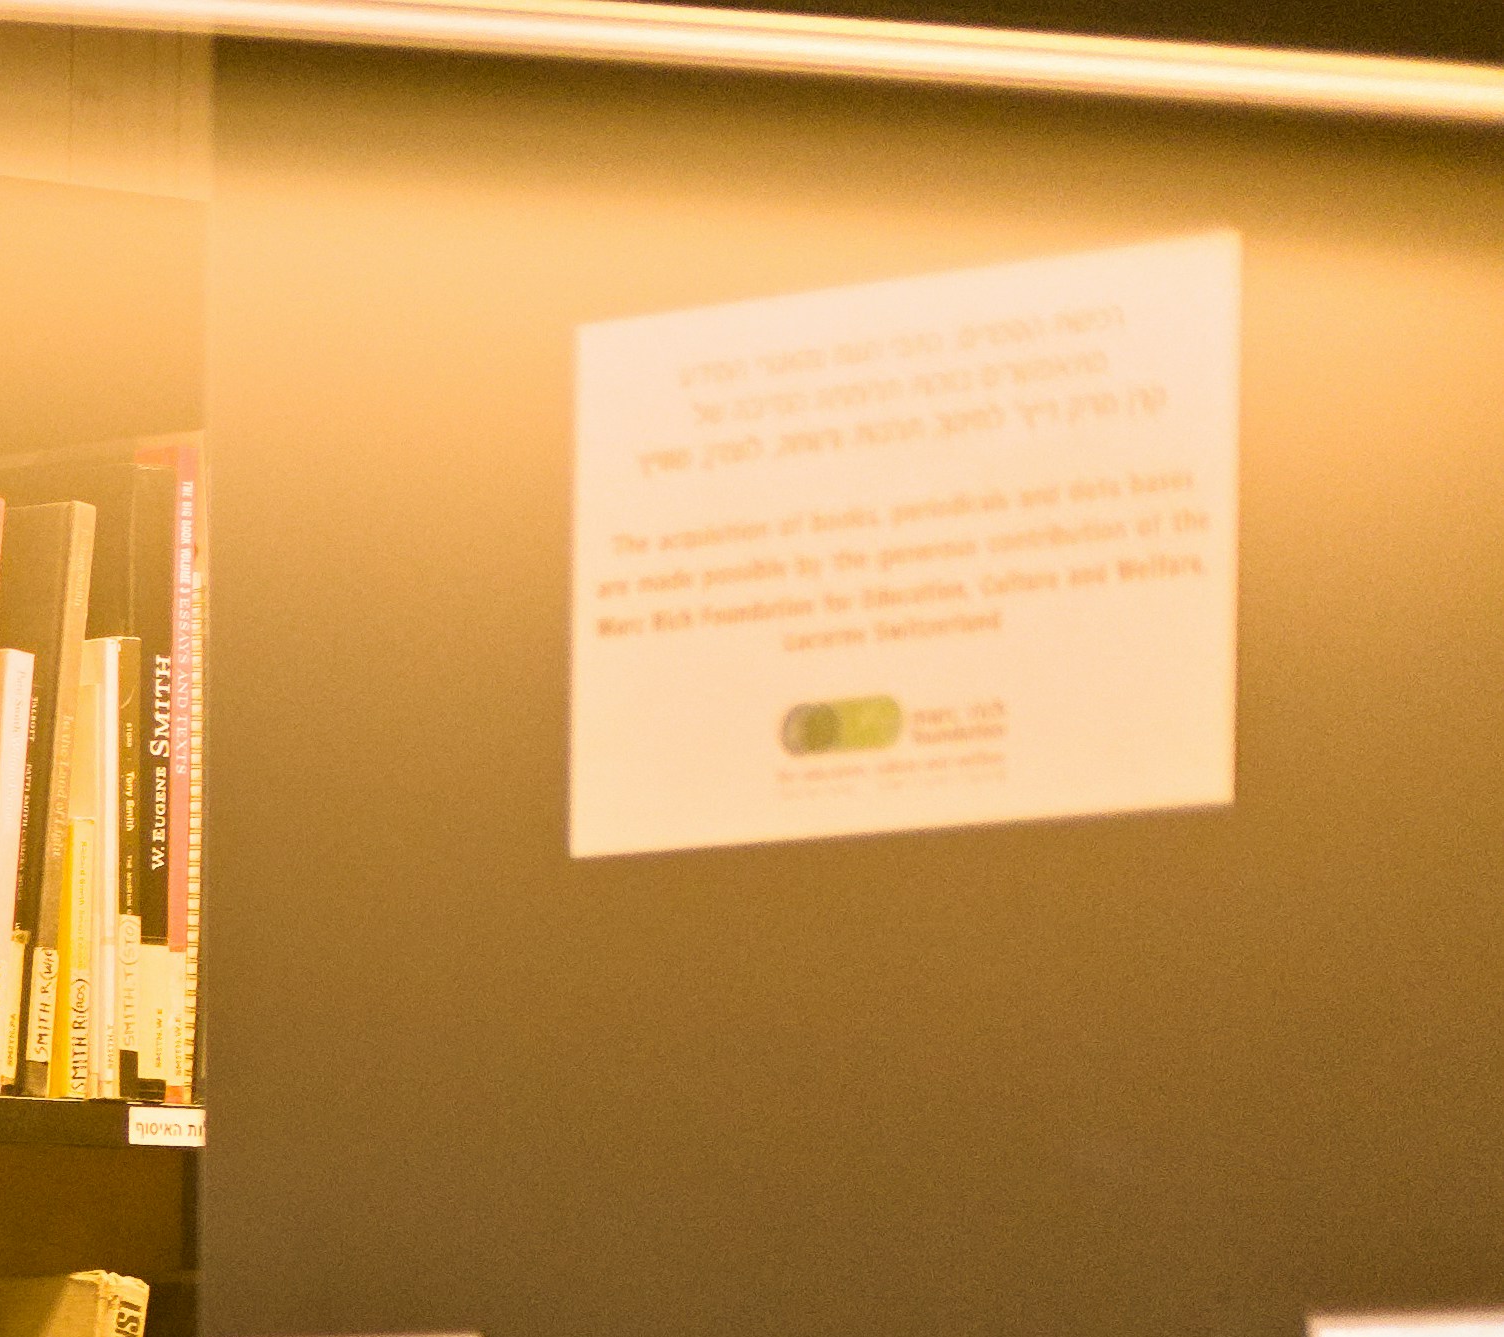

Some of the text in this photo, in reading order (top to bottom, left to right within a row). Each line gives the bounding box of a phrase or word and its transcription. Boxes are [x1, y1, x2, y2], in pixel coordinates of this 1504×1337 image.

[1019, 484, 1059, 507] and
[637, 568, 693, 593] made
[832, 551, 867, 571] the
[1172, 508, 1210, 532] the
[1068, 564, 1108, 584] and
[176, 598, 190, 664] ESSAYS
[149, 655, 171, 757] SMITH
[176, 669, 188, 708] AND
[175, 713, 188, 774] TEXTS
[124, 772, 136, 831] Tony Smith
[154, 766, 167, 832] EUGENE
